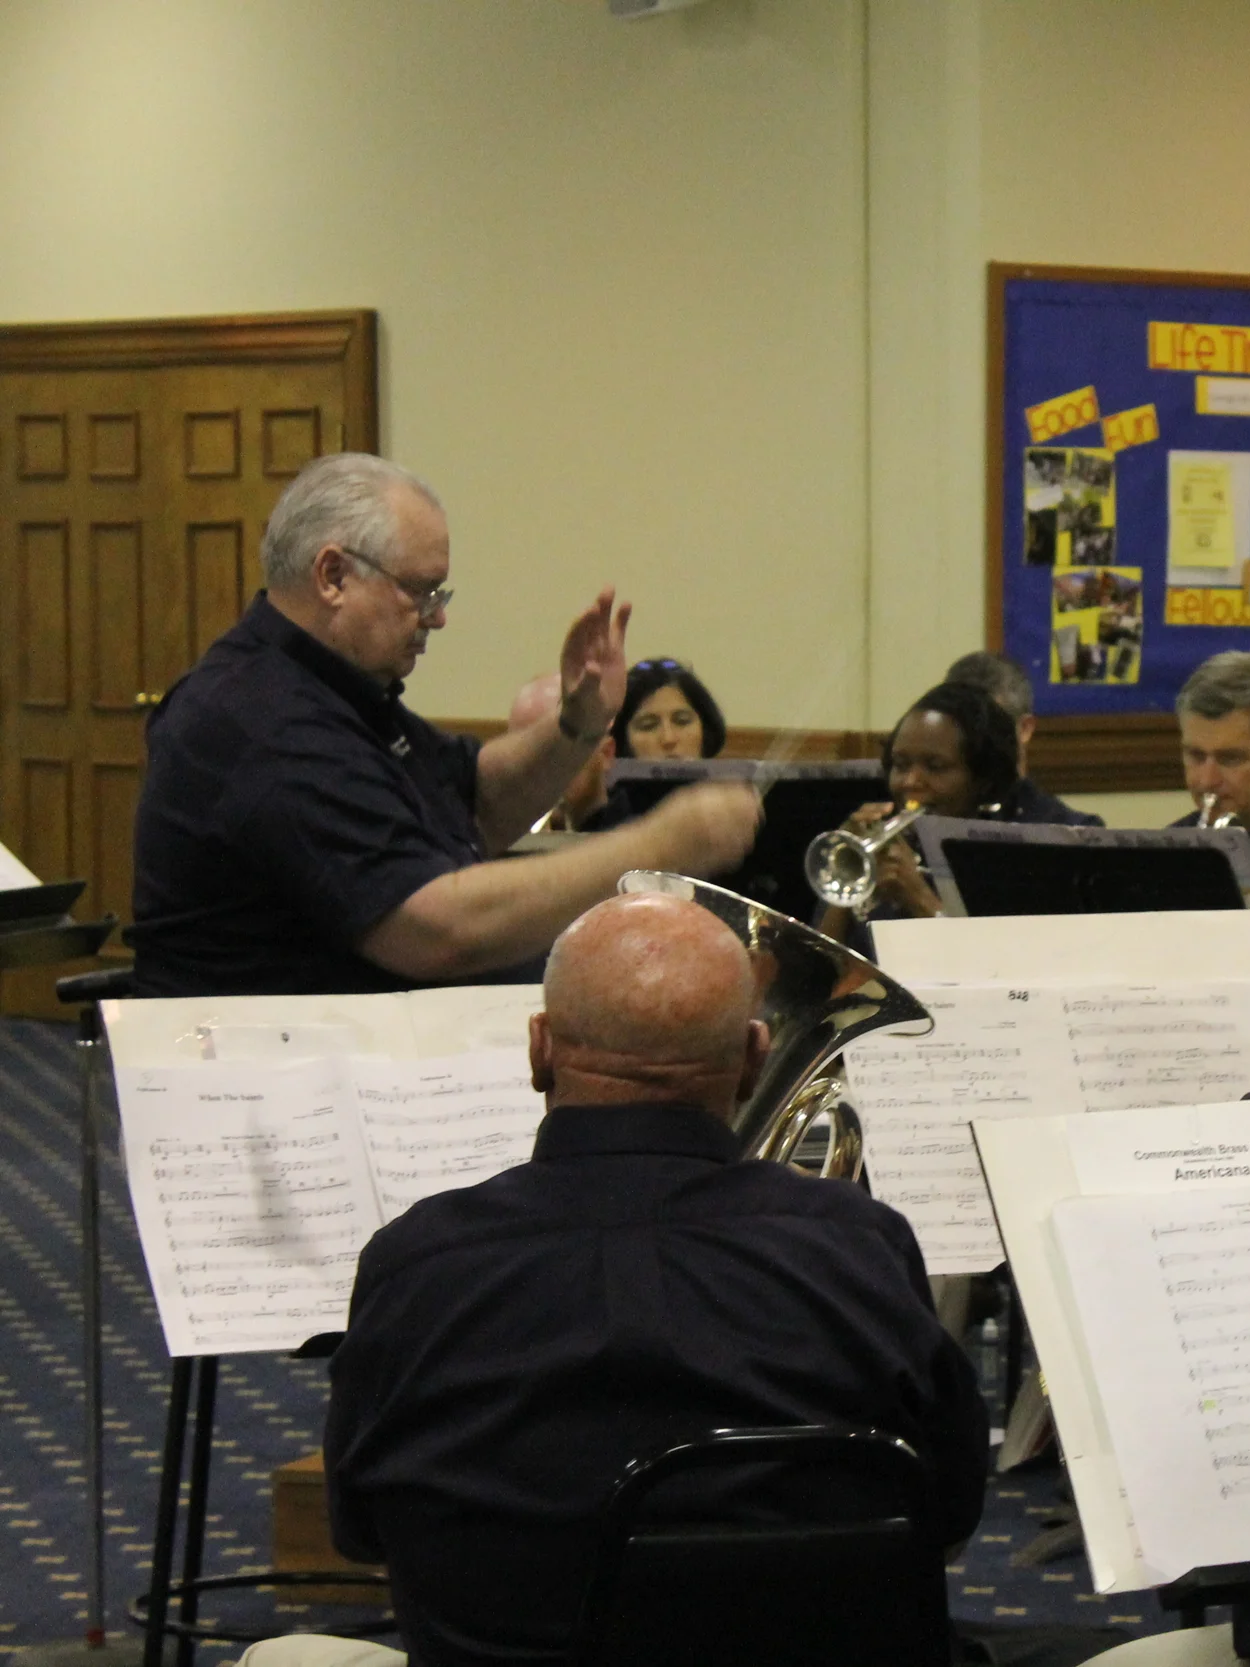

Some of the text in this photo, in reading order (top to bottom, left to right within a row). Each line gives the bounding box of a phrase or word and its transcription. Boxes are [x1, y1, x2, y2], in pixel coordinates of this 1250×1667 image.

[1148, 322, 1216, 371] Life
[1024, 386, 1099, 443] Food
[1102, 410, 1159, 452] Fun
[1134, 1146, 1216, 1160] Commonwealth
[1218, 1144, 1248, 1155] Brass
[1175, 1164, 1250, 1181] Americana
